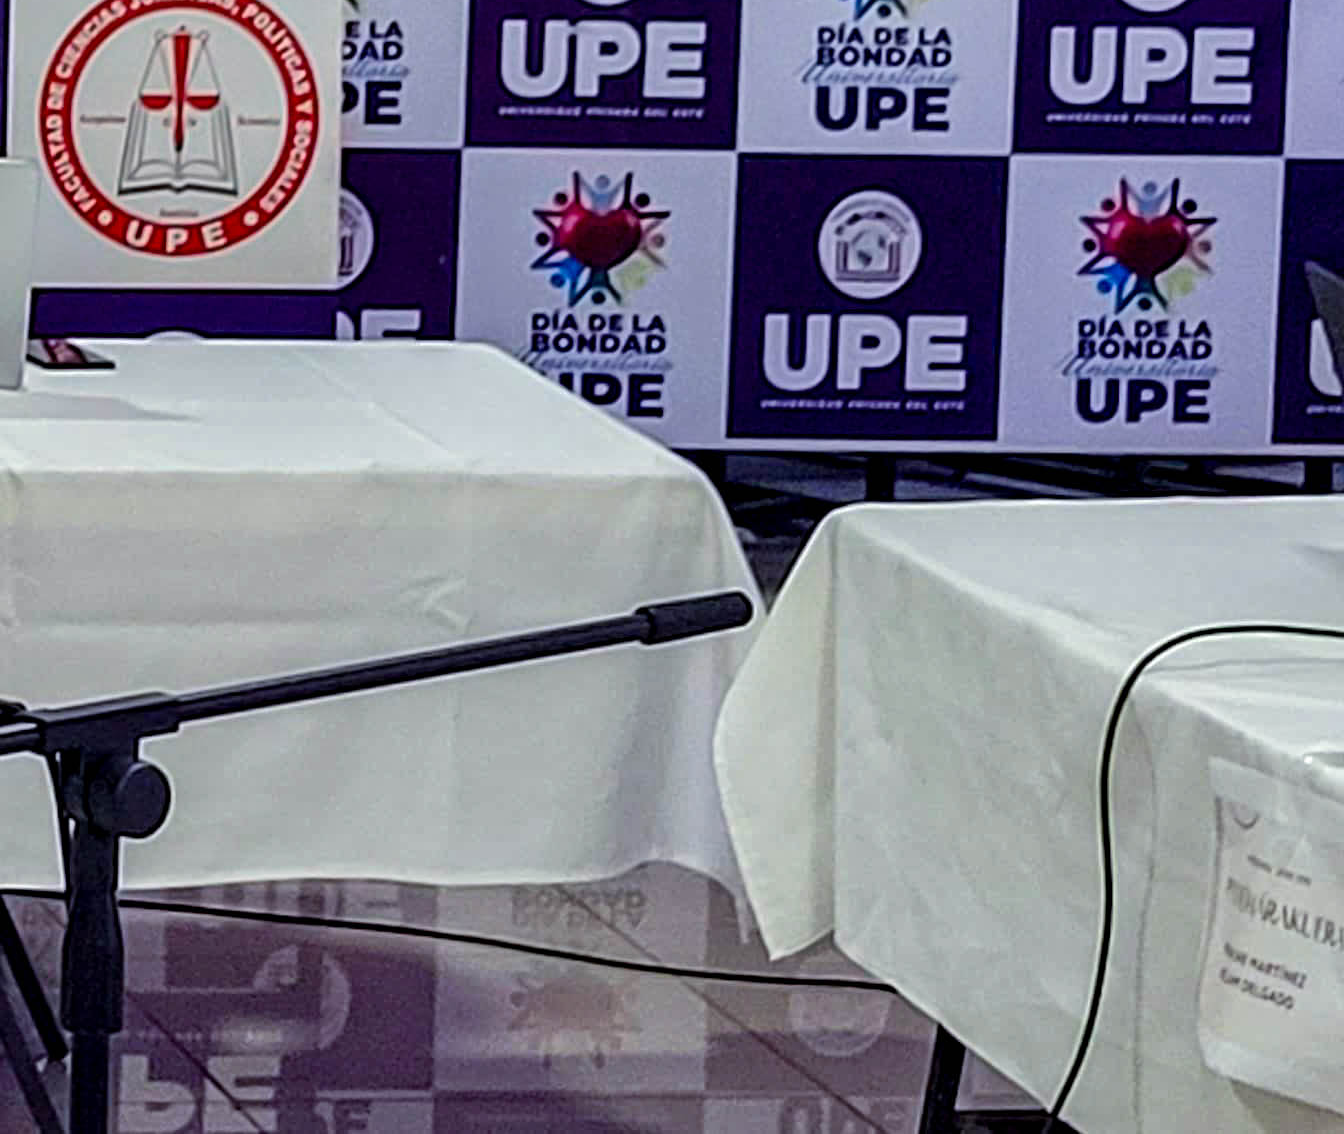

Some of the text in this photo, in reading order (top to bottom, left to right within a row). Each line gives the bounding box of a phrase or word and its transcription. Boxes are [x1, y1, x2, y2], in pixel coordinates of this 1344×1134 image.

[818, 23, 951, 46] DÍA DE LA
[502, 20, 705, 97] UPE
[815, 46, 951, 69] BONDAD
[1051, 27, 1253, 103] UPE
[816, 86, 950, 132] UPE
[127, 220, 226, 252] UPE
[532, 309, 666, 333] DÍA DE LA
[1078, 315, 1212, 339] DÍA DE LA
[530, 332, 666, 355] BONDAD
[765, 315, 966, 390] UPE
[1076, 339, 1212, 361] BONDAD
[1076, 378, 1211, 424] UPE
